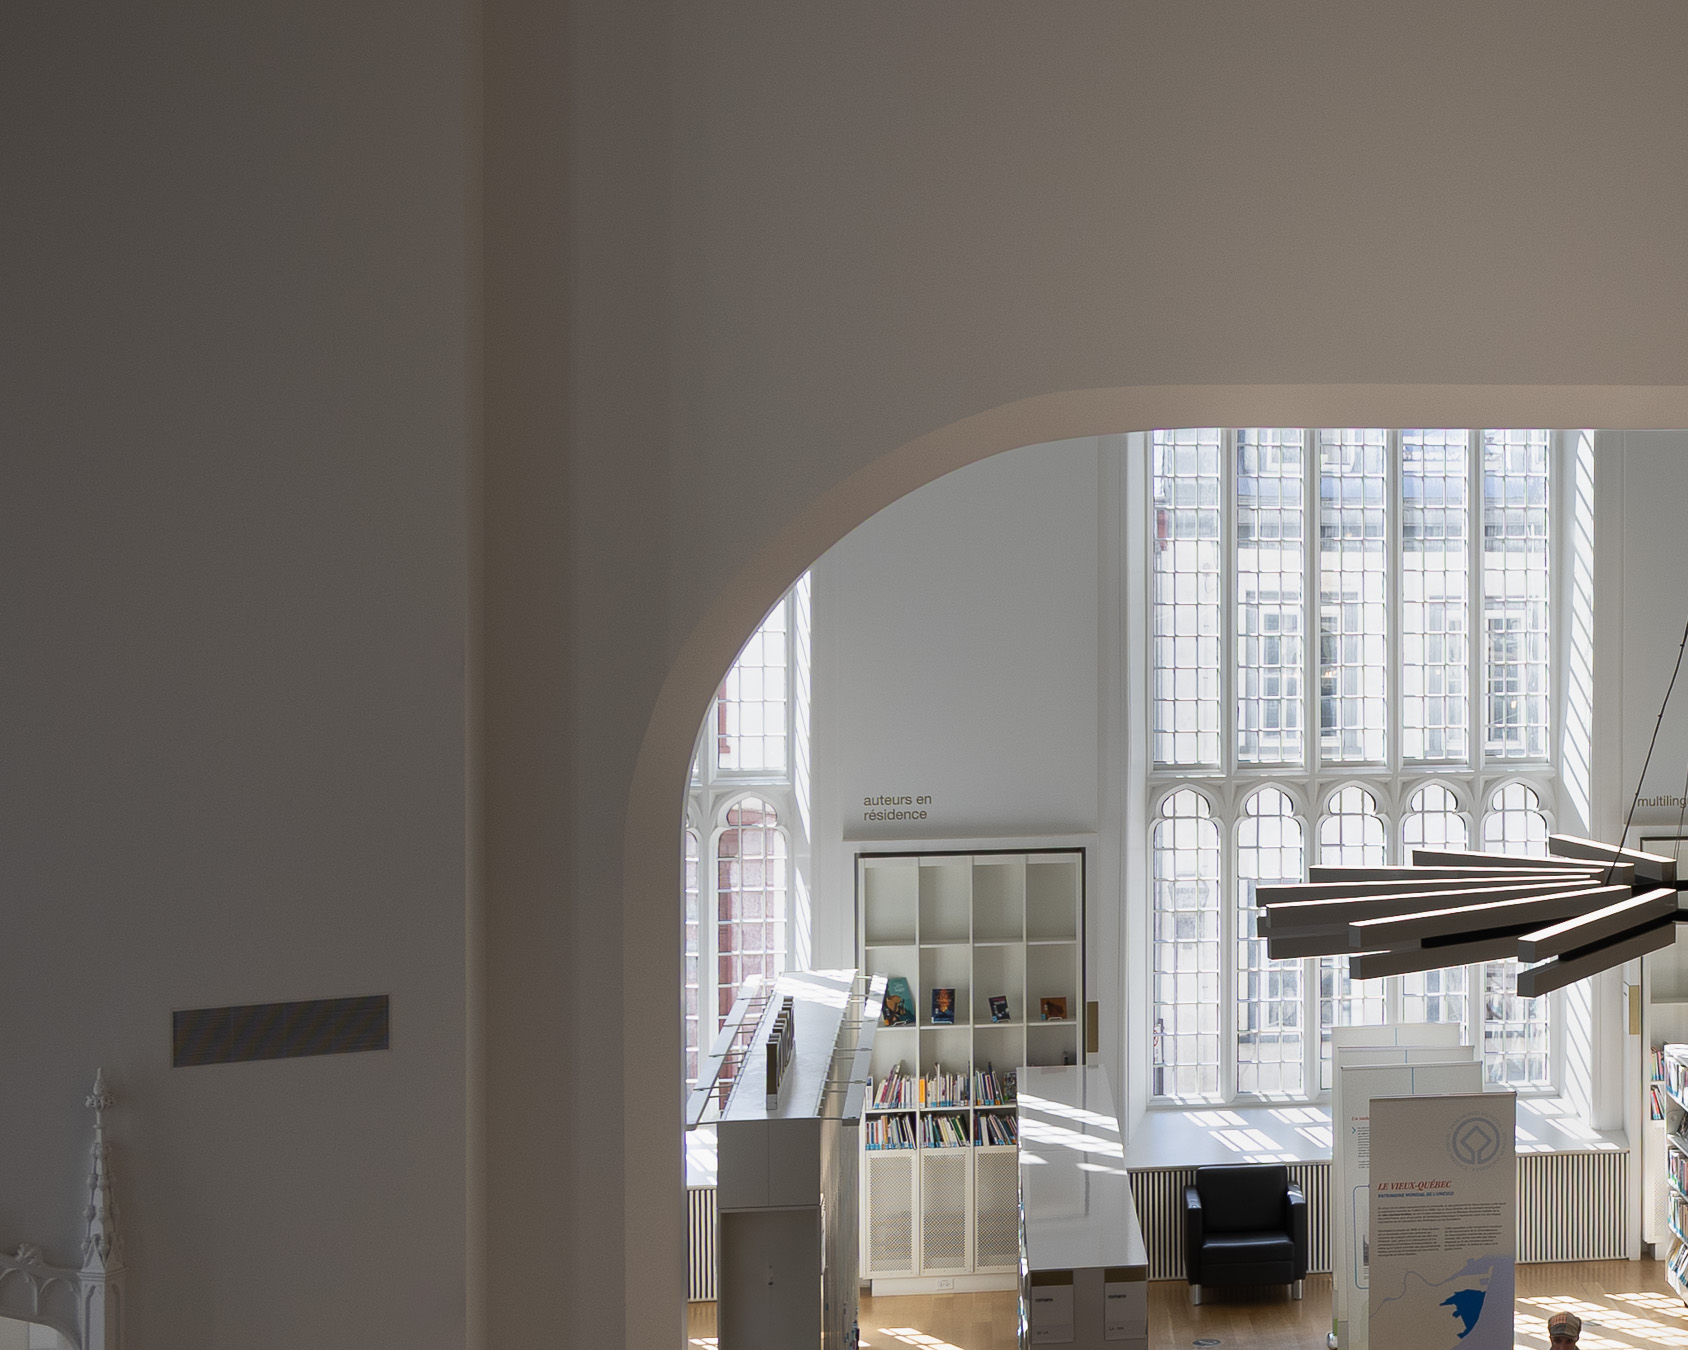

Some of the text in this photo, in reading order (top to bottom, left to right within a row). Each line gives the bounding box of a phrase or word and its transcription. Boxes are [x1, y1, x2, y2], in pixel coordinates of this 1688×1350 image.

[863, 795, 932, 806] auteurs en
[863, 809, 928, 821] résidence
[1377, 1179, 1452, 1191] LE VIEUX-QUÉBEC
